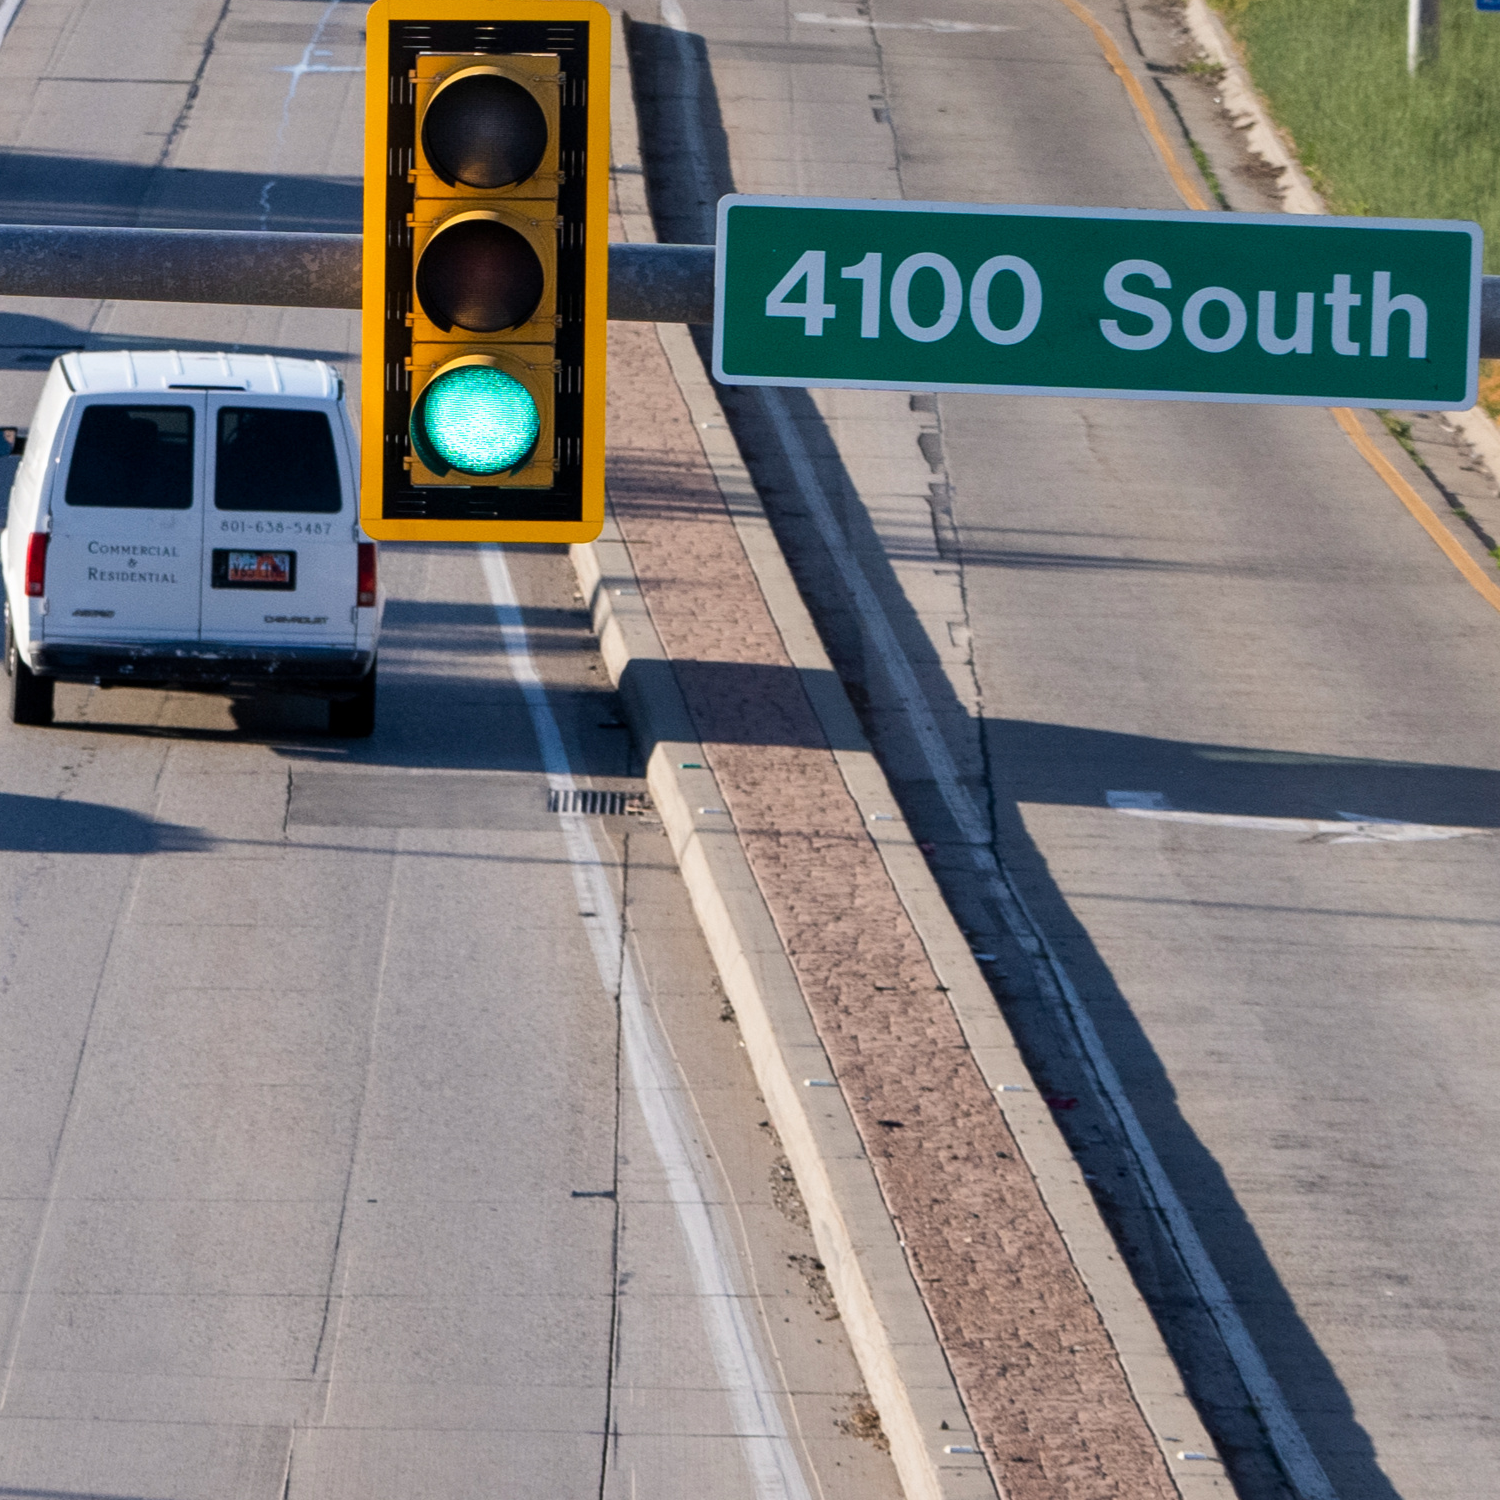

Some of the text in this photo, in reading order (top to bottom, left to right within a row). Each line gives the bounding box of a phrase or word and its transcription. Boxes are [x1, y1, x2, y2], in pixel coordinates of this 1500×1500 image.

[765, 249, 1429, 360] 4100 South
[220, 520, 332, 535] 801-638-5487
[87, 540, 180, 557] COMMERCIAL
[127, 558, 138, 568] &
[87, 566, 178, 584] RESIDENTIAL
